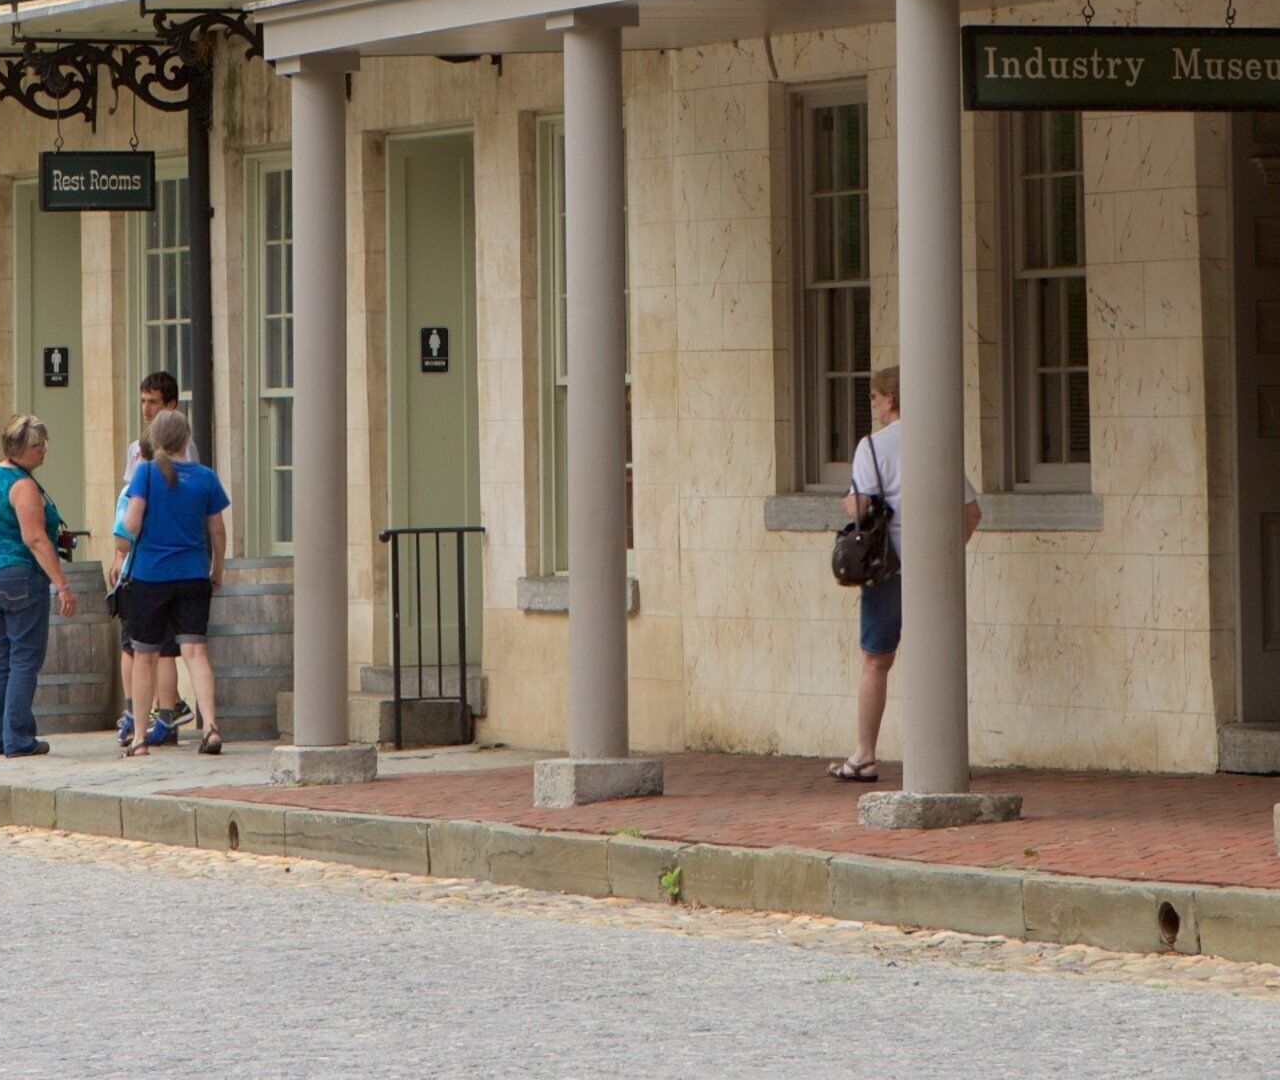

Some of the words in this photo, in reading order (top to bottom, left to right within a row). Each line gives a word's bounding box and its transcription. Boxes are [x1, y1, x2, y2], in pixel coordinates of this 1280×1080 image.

[983, 46, 1146, 87] Industry
[52, 169, 86, 191] Rest
[89, 169, 142, 190] Rooms
